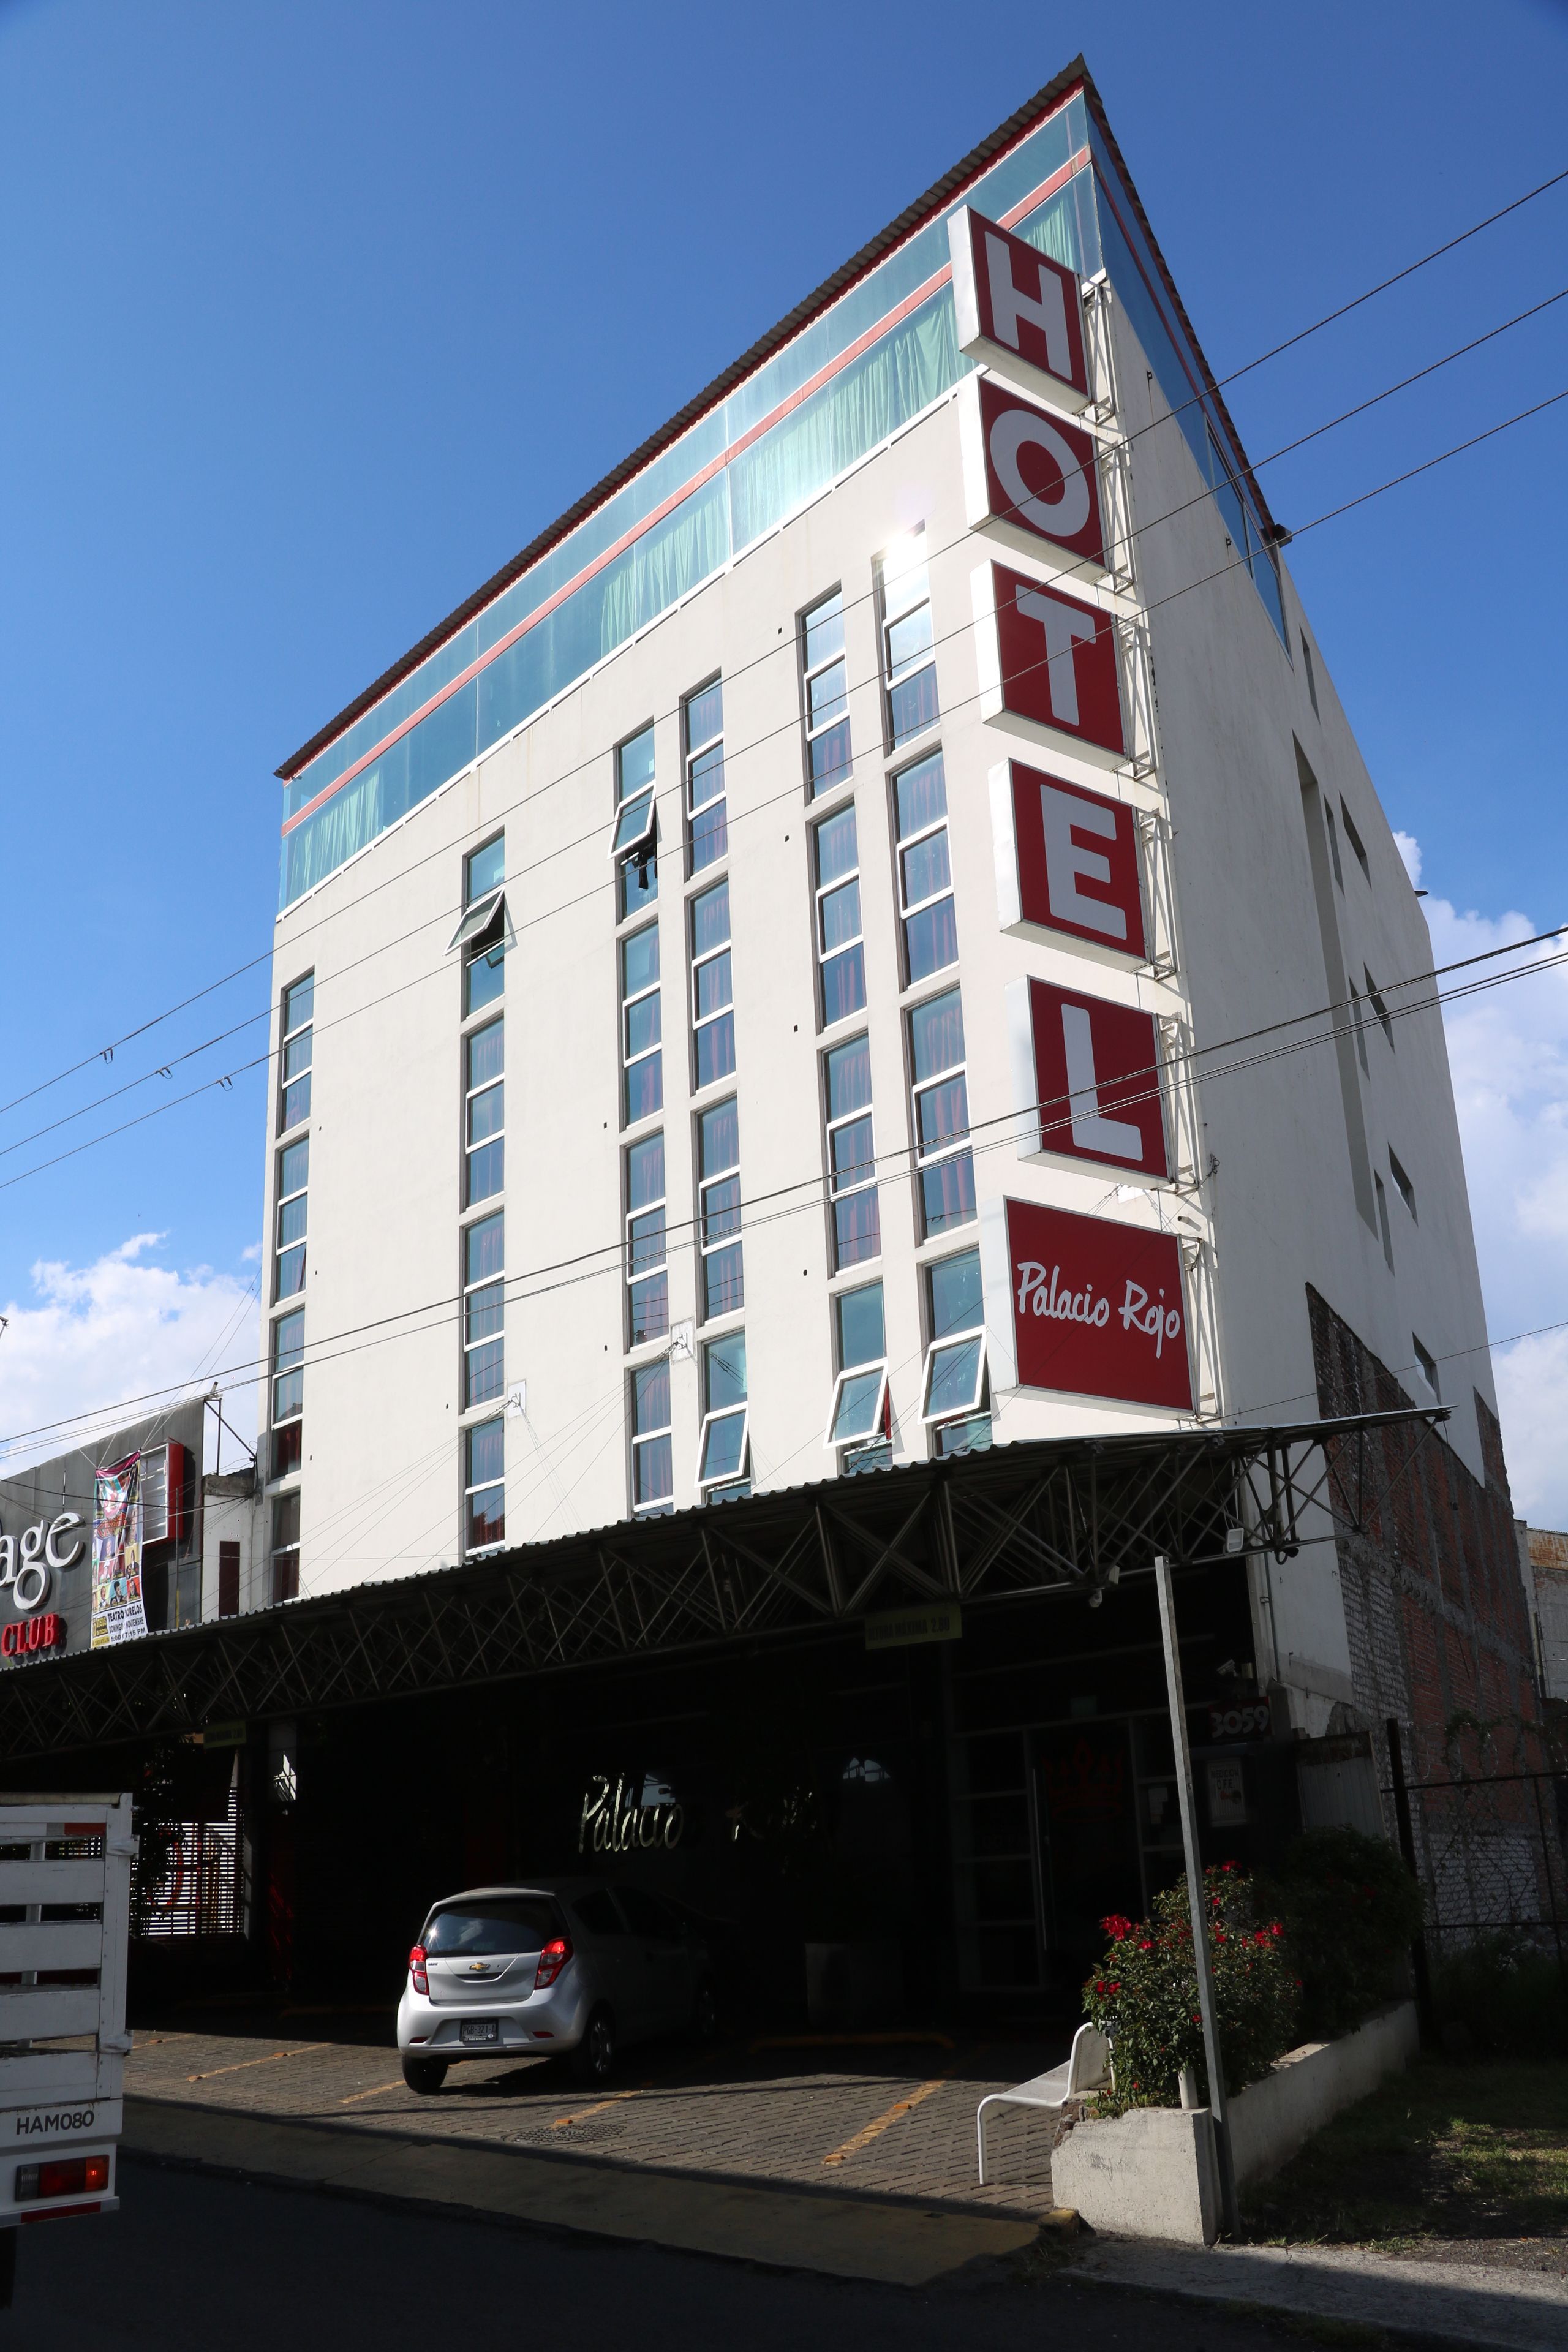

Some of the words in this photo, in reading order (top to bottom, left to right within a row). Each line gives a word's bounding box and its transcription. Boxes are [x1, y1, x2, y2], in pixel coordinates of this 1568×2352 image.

[984, 230, 1144, 1161] HOTEL
[1017, 1261, 1110, 1327] Palacio
[1118, 1279, 1180, 1359] Rojo
[108, 1611, 124, 1622] TEATRO
[109, 1623, 123, 1633] DOMINGO
[126, 1618, 144, 1627] NOVIEMBRE
[1, 1613, 59, 1657] CLUB
[125, 1629, 136, 1638] 7:15
[1210, 1705, 1270, 1738] 3059
[462, 2025, 496, 2035] PGB-321-A
[16, 2110, 94, 2135] HAM080
